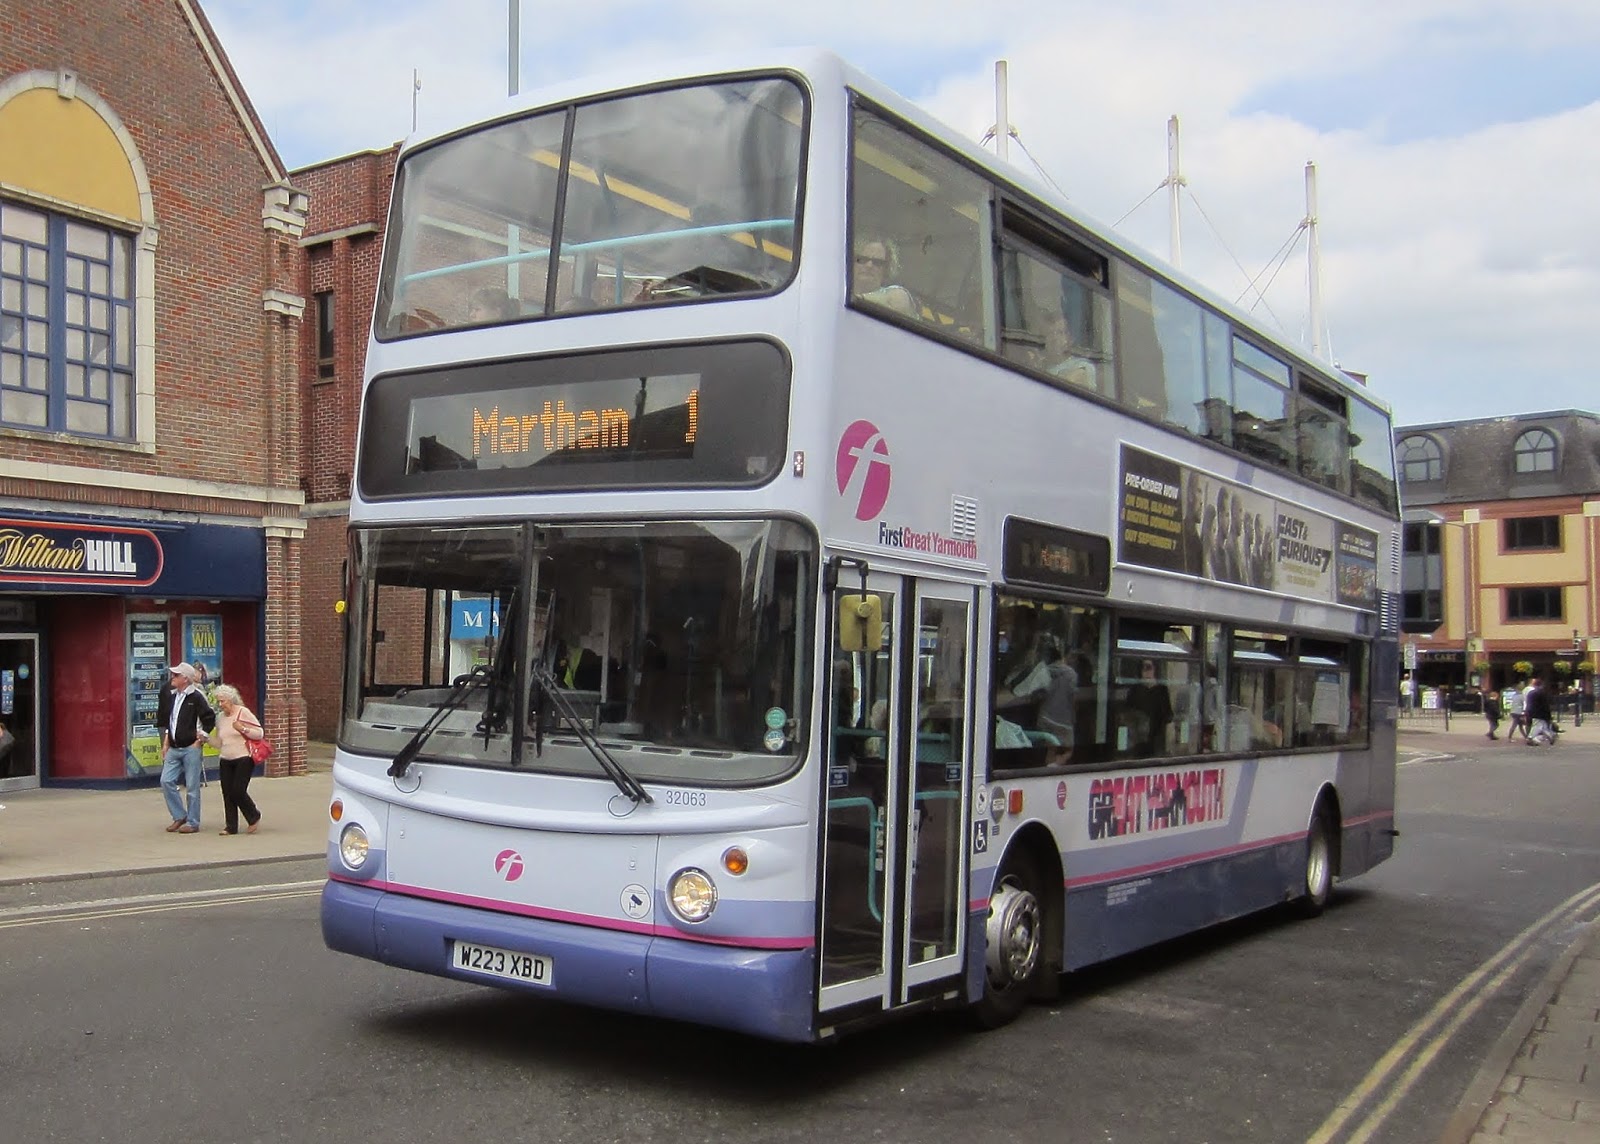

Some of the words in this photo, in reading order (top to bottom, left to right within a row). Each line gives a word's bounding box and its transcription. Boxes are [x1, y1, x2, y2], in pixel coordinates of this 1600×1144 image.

[473, 399, 630, 455] Martham
[685, 389, 698, 443] 1
[1125, 472, 1163, 496] PRE-ORDER
[1277, 514, 1305, 540] FAST
[0, 528, 86, 570] William
[87, 539, 137, 573] HILL
[932, 531, 977, 559] Yarmouth
[192, 632, 216, 648] WIN
[142, 745, 157, 754] FUN
[666, 790, 706, 806] 32063
[461, 945, 505, 973] W223
[510, 954, 544, 980] XBD
